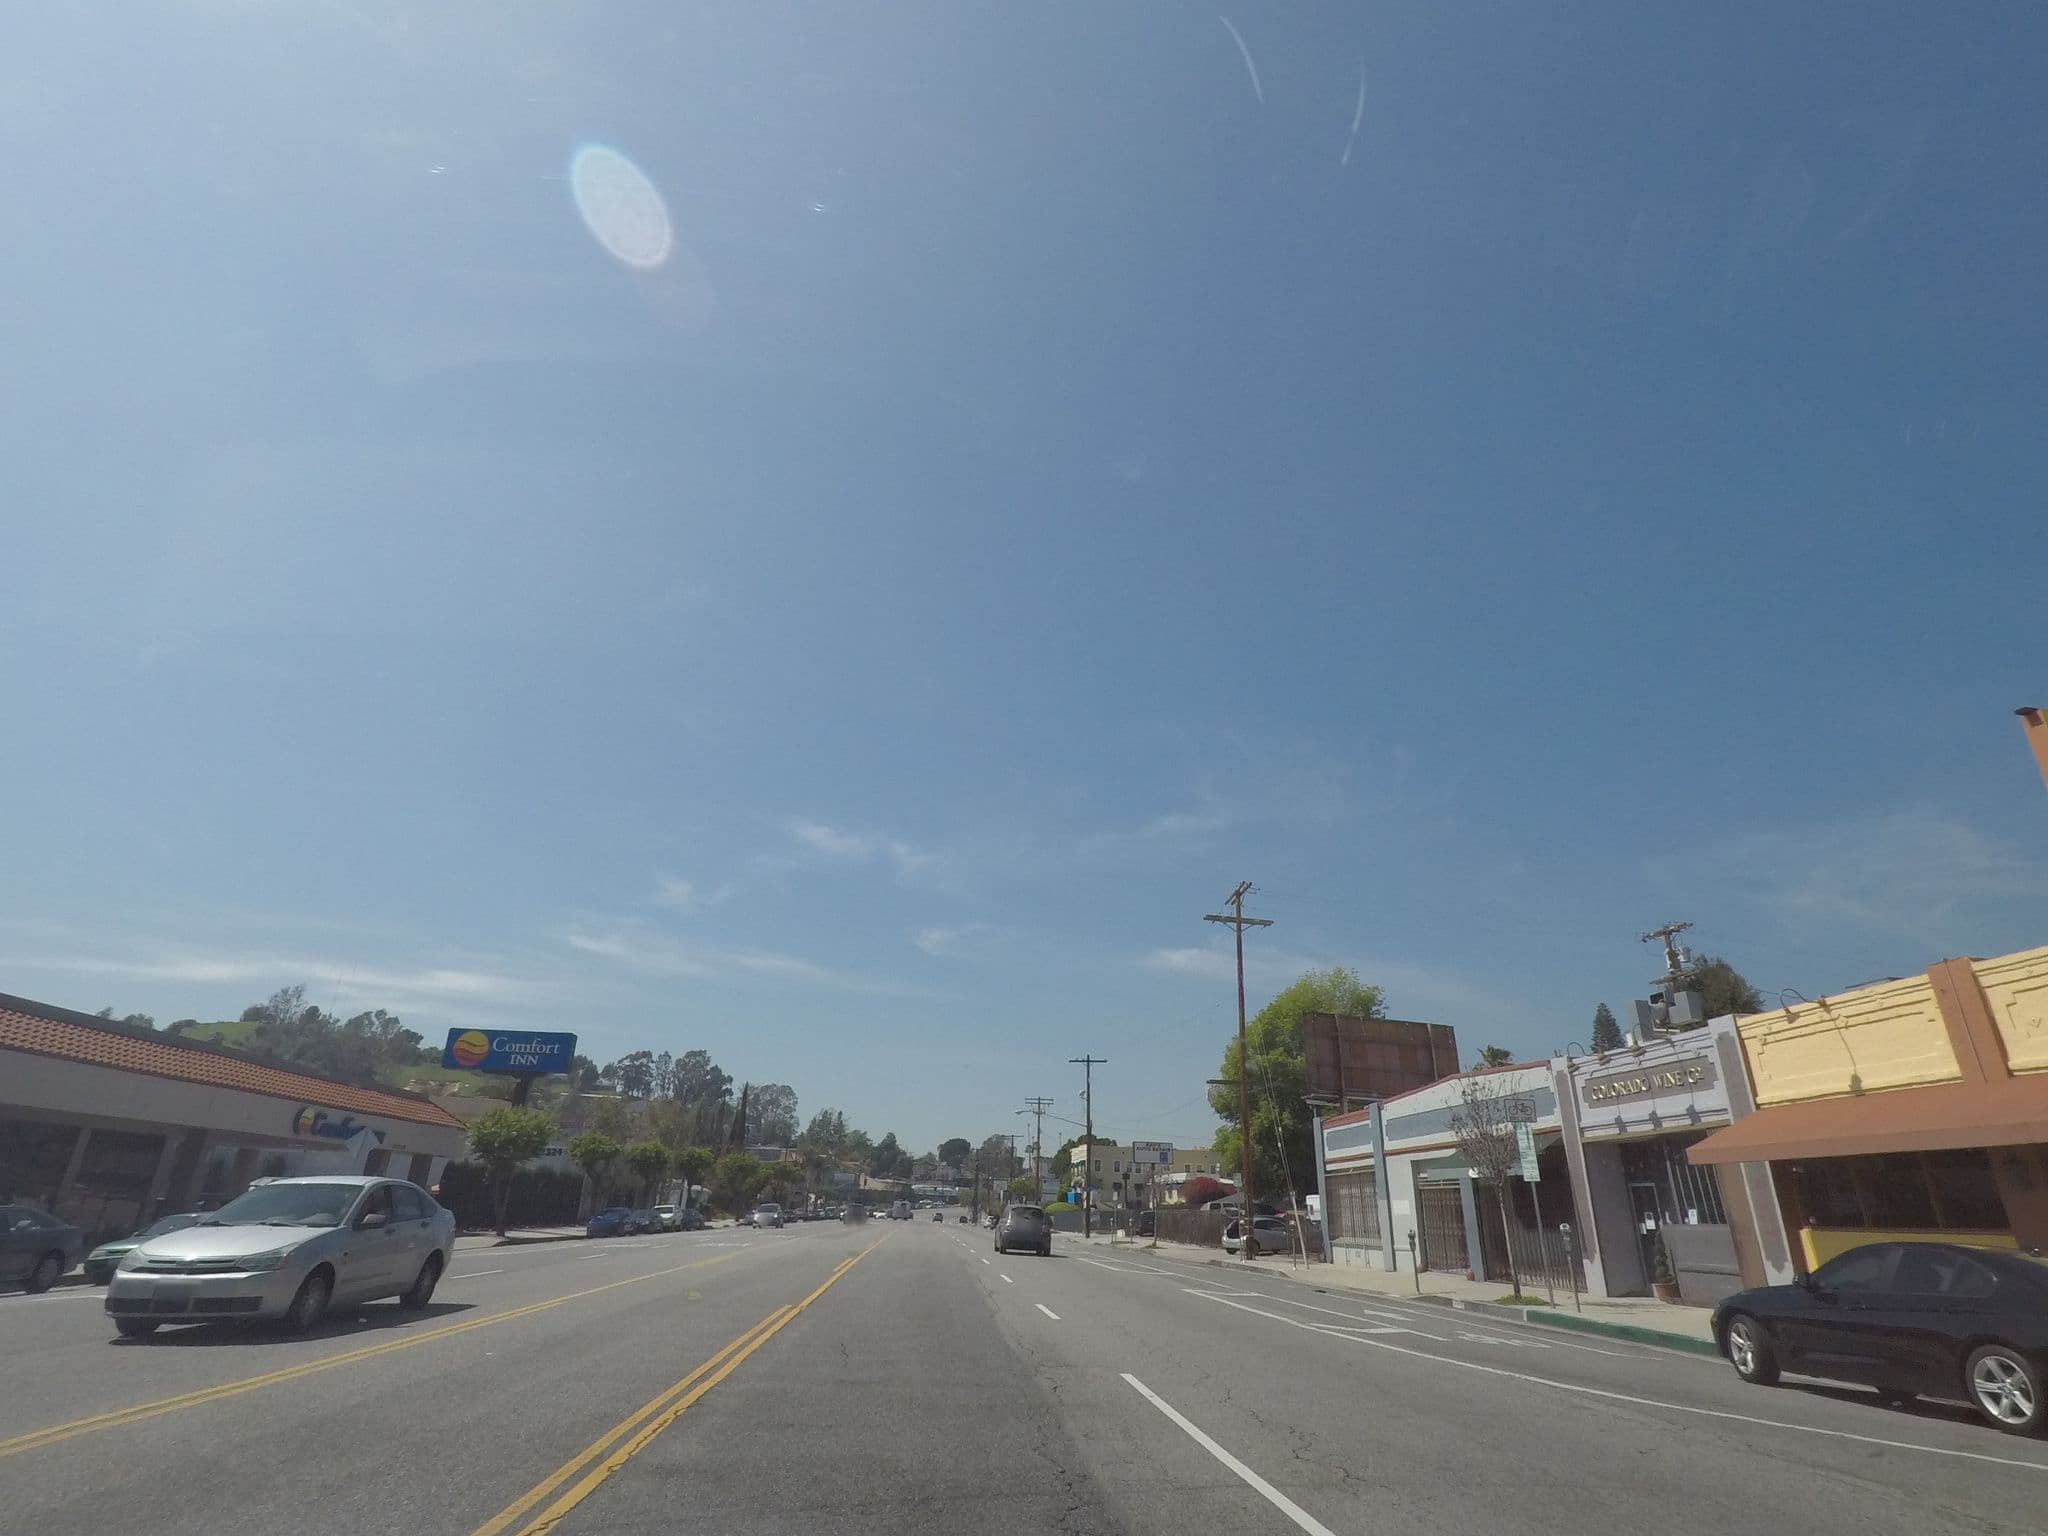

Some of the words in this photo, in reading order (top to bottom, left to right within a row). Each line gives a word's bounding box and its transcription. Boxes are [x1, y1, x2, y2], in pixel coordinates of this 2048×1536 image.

[492, 1037, 560, 1054] Comfort
[509, 1055, 539, 1065] INN
[1591, 1079, 1650, 1100] COLORADO
[1653, 1070, 1684, 1088] WINE
